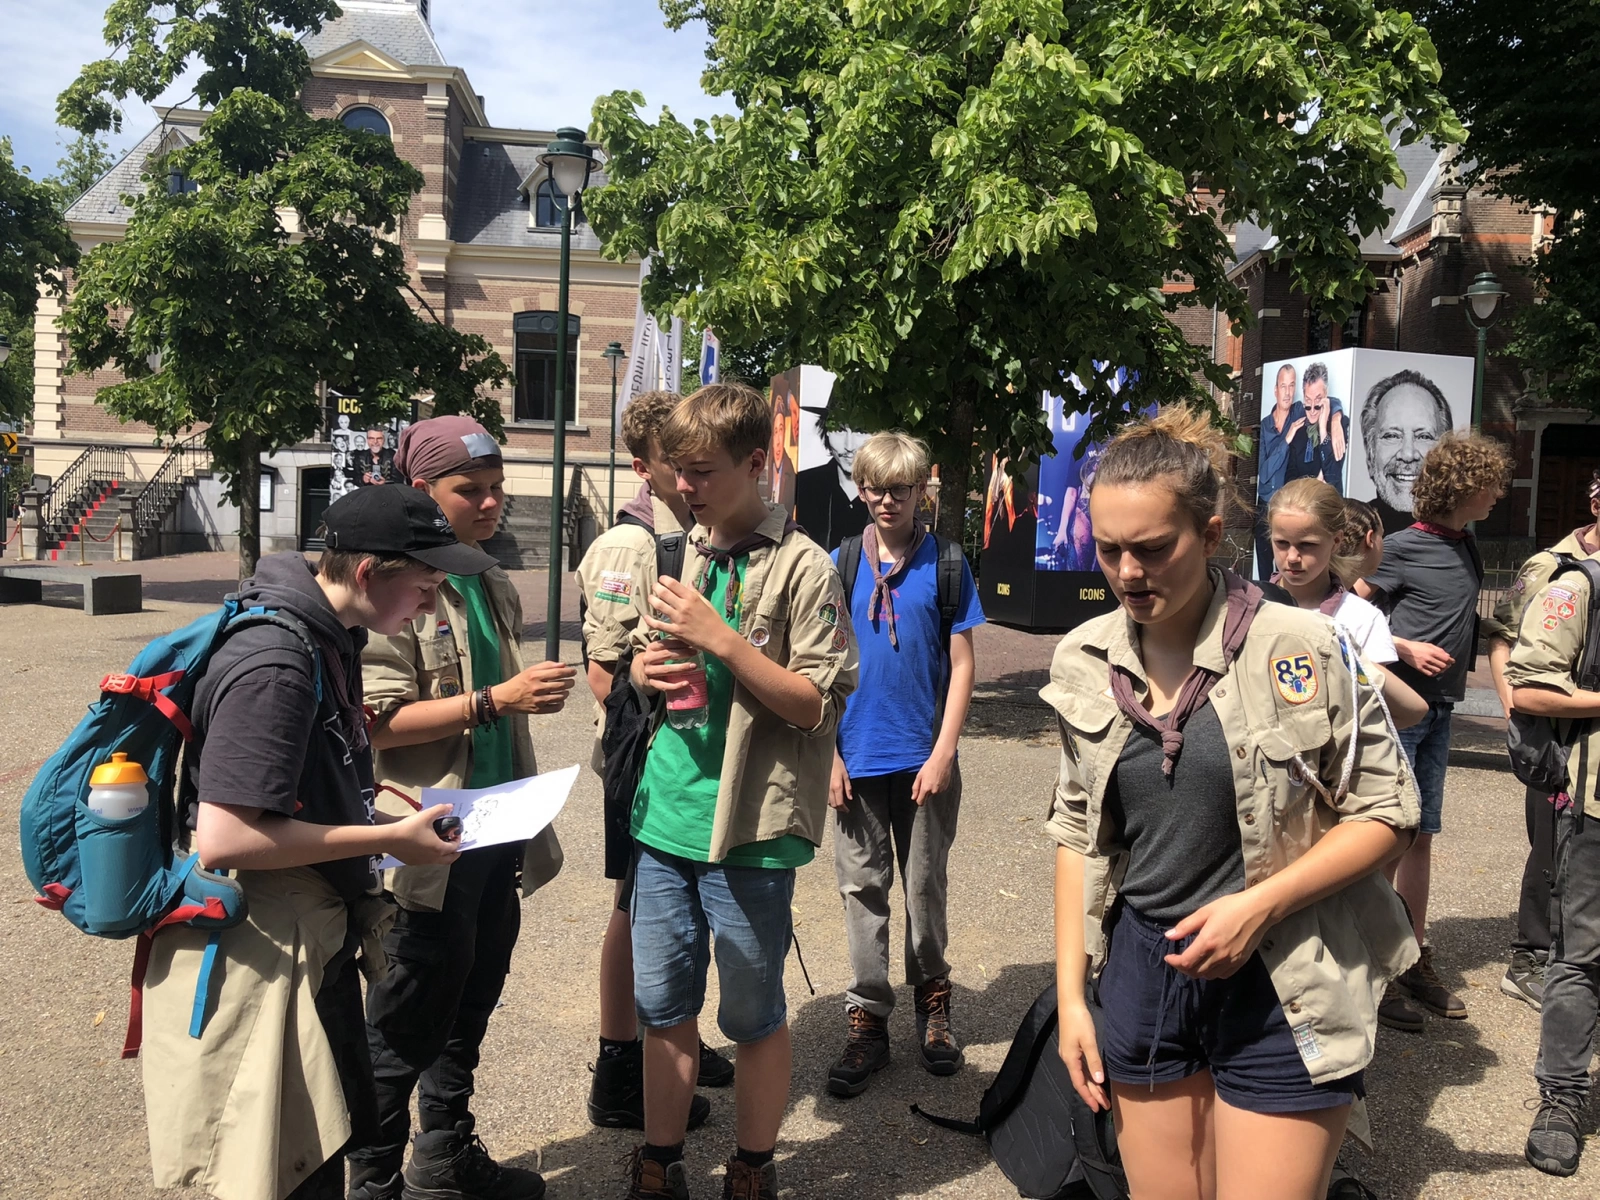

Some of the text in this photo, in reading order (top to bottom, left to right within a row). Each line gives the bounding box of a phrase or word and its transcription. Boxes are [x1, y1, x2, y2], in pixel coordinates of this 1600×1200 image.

[338, 398, 361, 414] ICO
[997, 583, 1010, 596] ICONS
[1079, 588, 1105, 600] ICONS
[1275, 656, 1313, 684] 85
